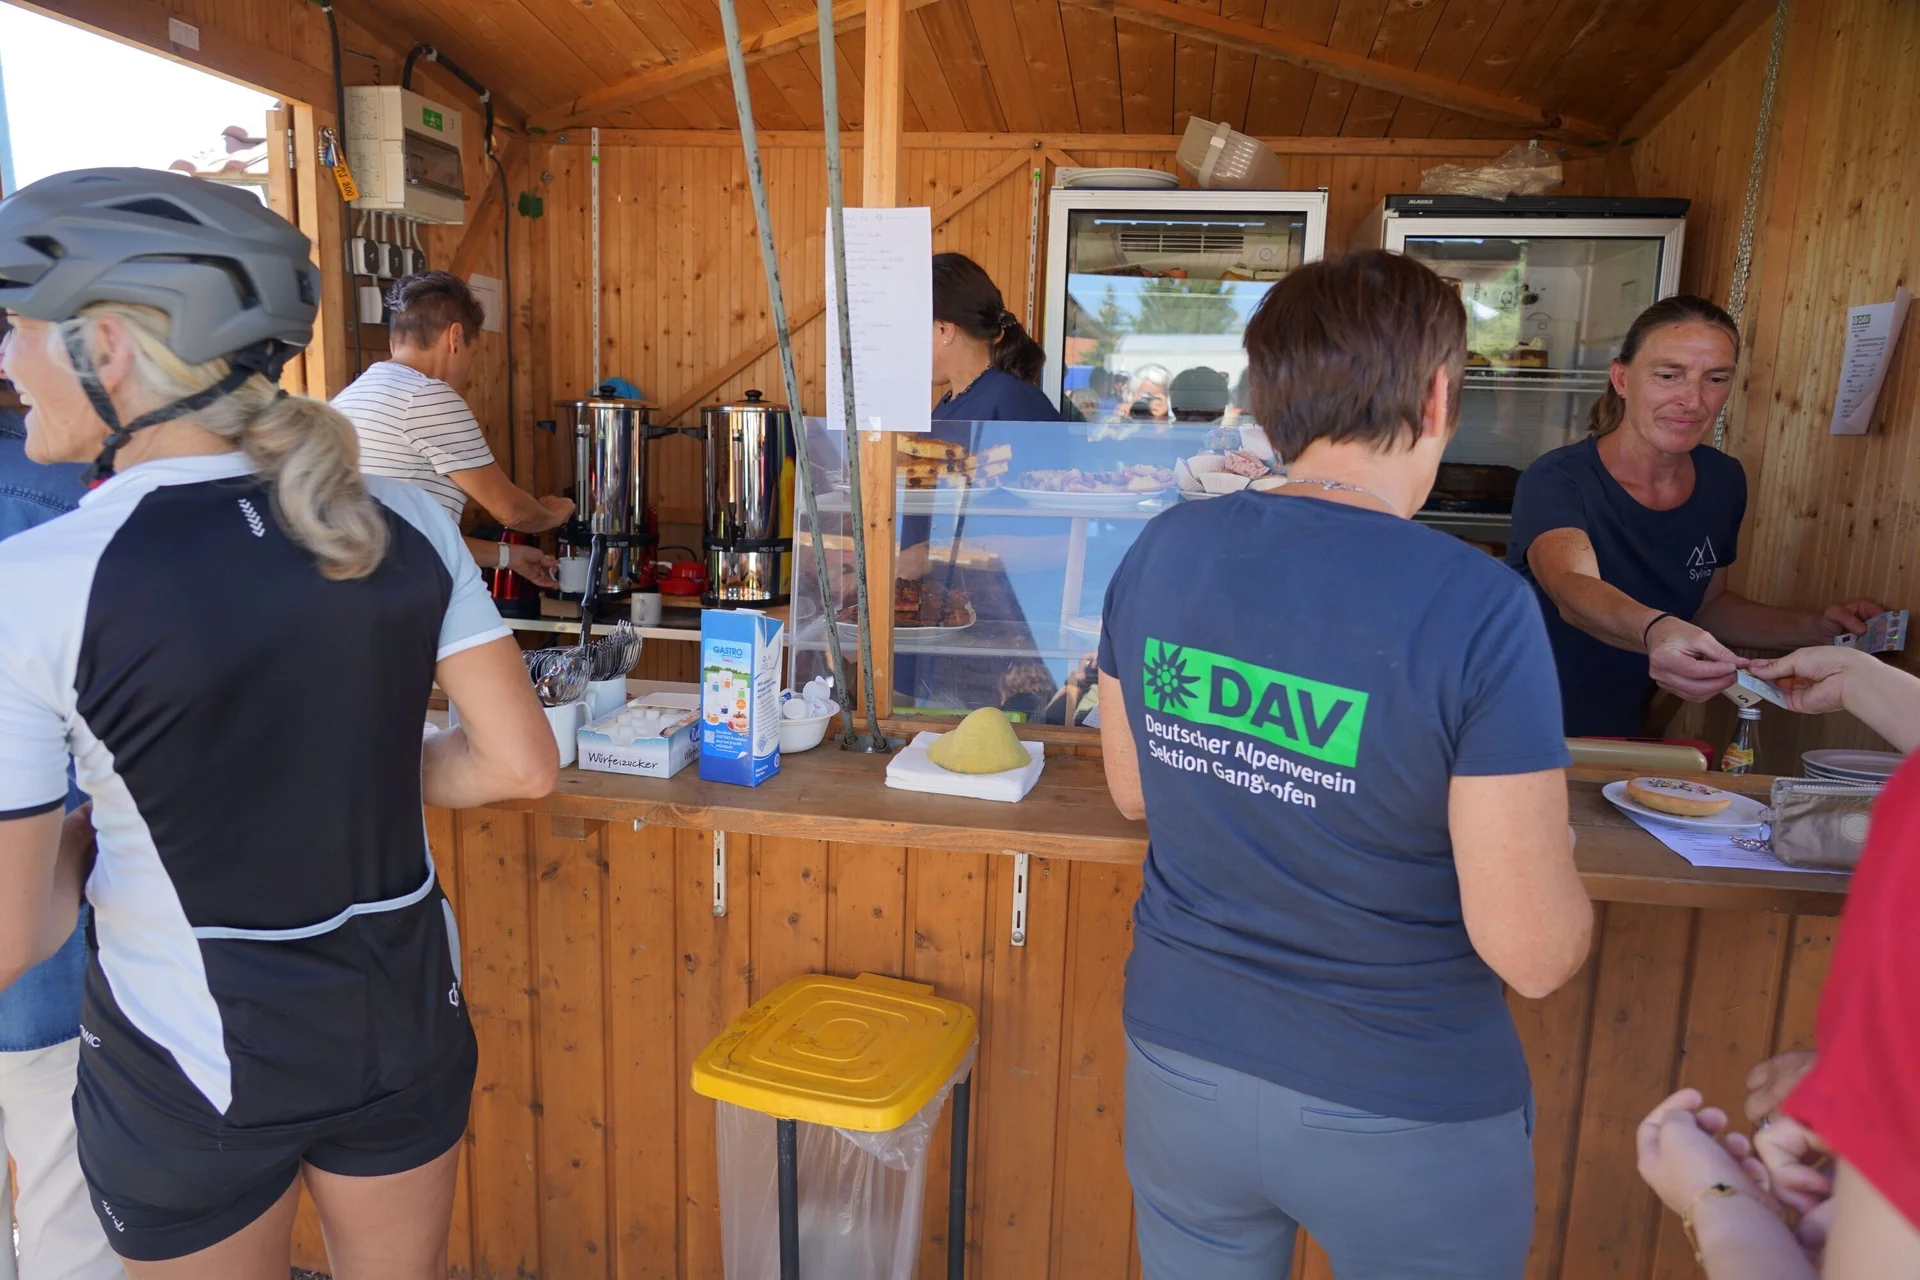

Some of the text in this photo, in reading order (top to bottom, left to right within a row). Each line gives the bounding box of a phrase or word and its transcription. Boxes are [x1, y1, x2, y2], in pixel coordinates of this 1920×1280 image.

[341, 181, 355, 197] 200
[713, 645, 743, 656] GASTRO
[1208, 664, 1353, 750] DAV
[1145, 713, 1357, 794] Deutscher Alpenverein
[1149, 739, 1208, 774] Sektion
